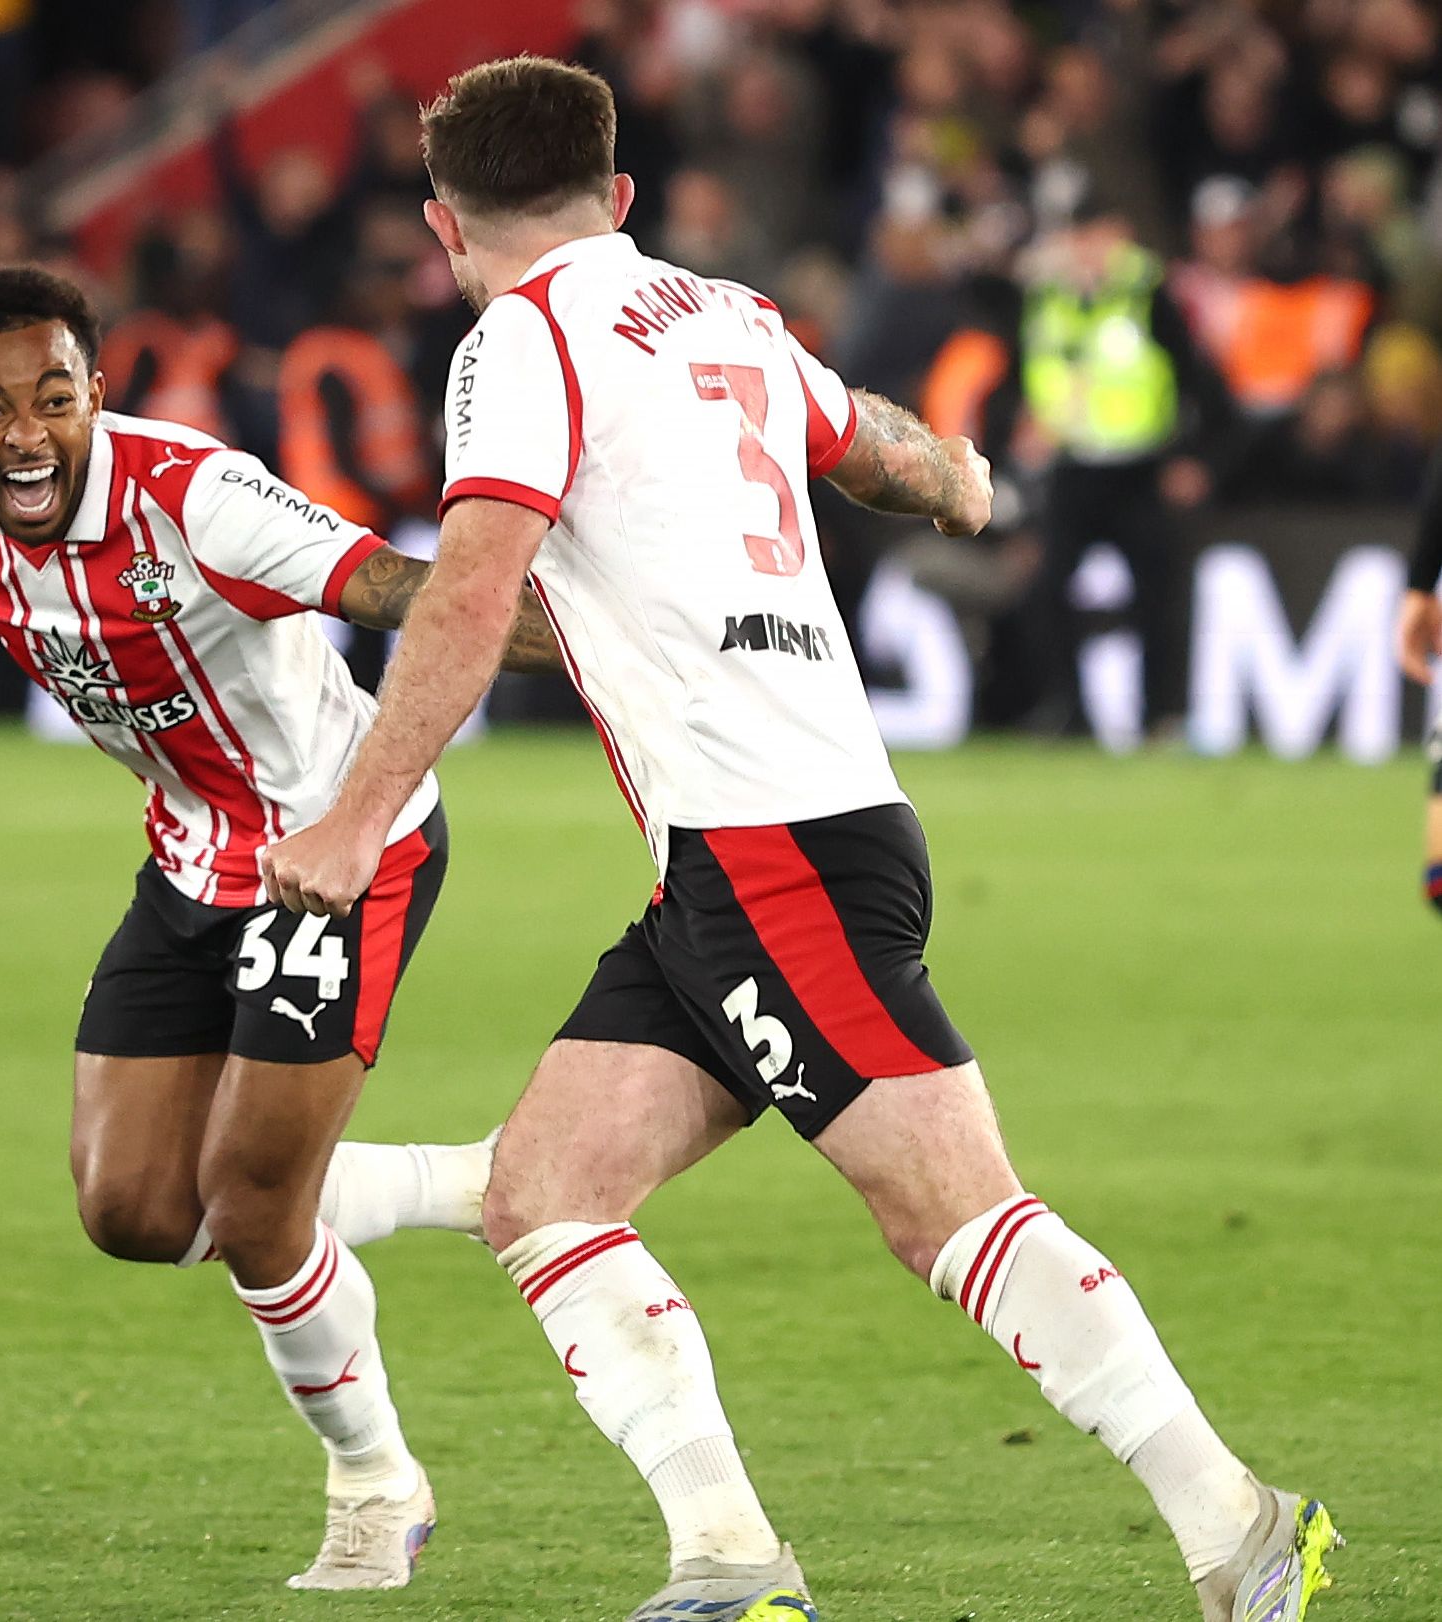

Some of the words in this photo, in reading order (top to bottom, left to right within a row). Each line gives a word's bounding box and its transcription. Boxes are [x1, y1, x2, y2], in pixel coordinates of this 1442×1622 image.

[613, 276, 775, 356] MANN
[220, 469, 340, 532] GARMIN
[687, 362, 806, 577] 3
[69, 691, 196, 733] CRUISES
[236, 908, 350, 1000] 34
[721, 975, 793, 1085] 3
[1079, 1266, 1121, 1293] SA
